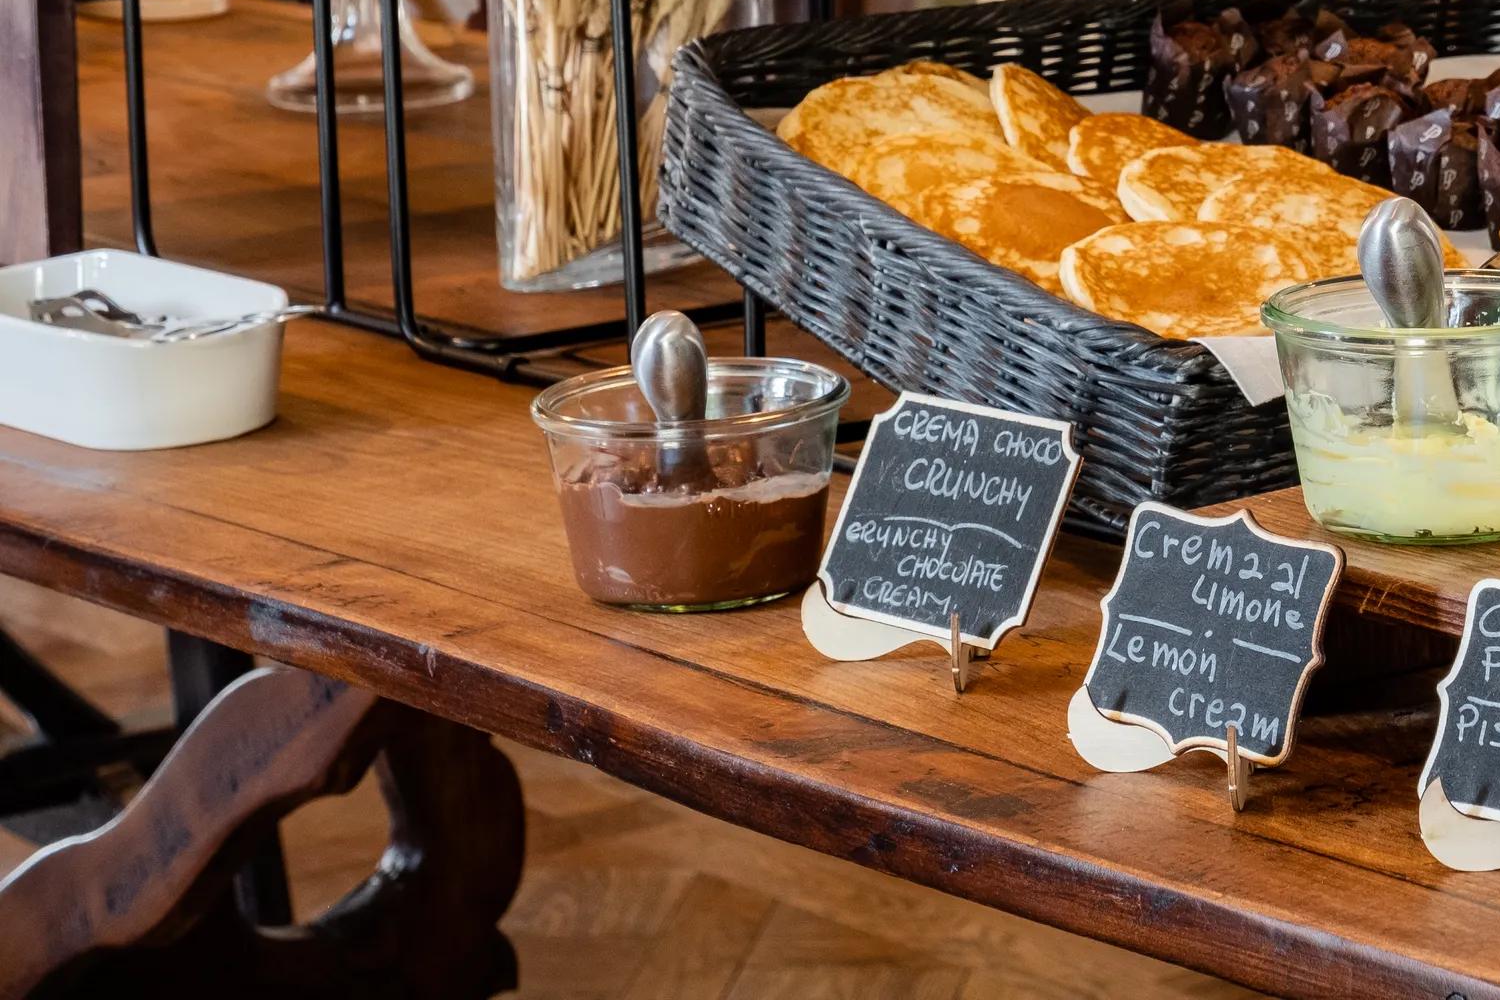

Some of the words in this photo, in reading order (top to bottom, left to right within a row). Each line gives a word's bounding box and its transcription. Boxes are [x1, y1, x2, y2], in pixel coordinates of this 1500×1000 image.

[894, 410, 980, 457] CREMA
[993, 430, 1063, 466] CHOCO
[904, 458, 1033, 522] CRUNCHY
[845, 520, 953, 564] CRUNCHY
[1135, 521, 1264, 580] Crema
[1106, 623, 1217, 682] Lemon
